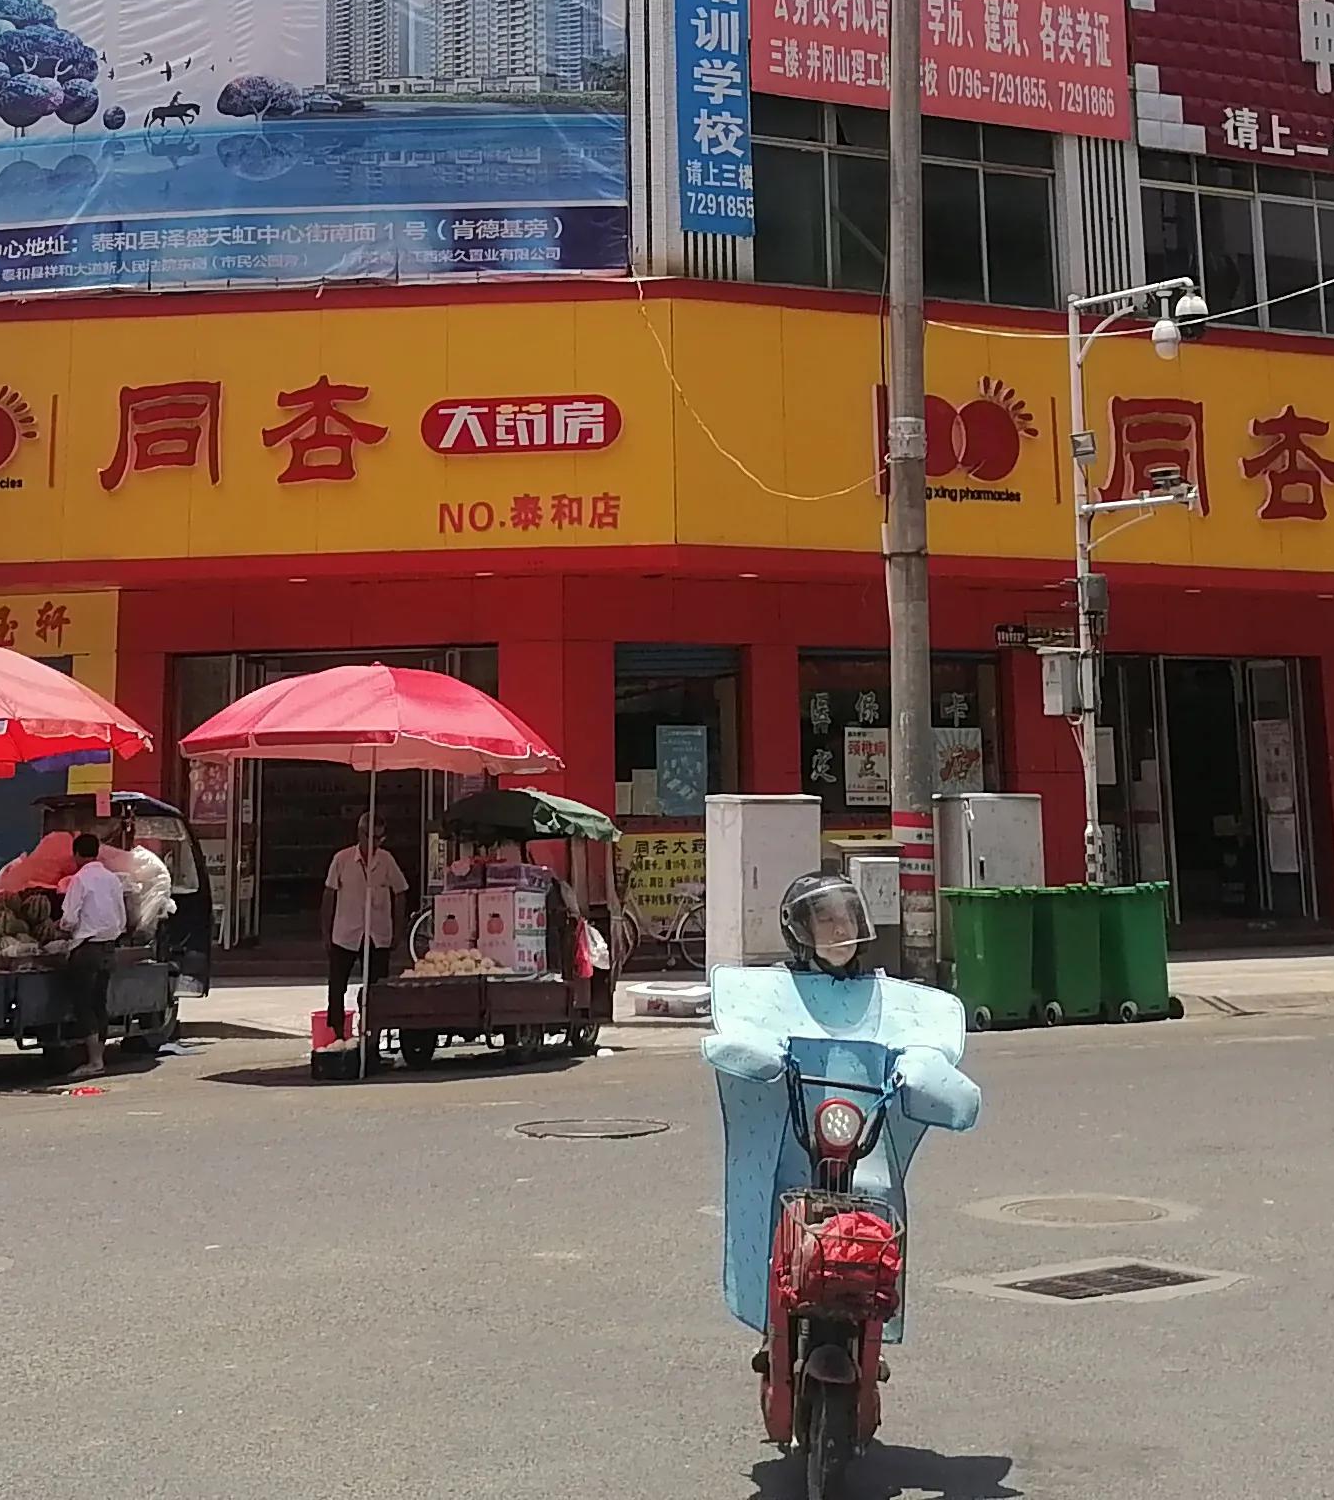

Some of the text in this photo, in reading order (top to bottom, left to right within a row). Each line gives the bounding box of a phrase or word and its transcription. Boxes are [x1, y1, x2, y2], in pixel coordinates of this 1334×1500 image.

[685, 158, 754, 191] 请上三楼
[686, 191, 755, 219] 7291855
[99, 373, 605, 493] 同杏 大药房
[933, 487, 958, 501] xing
[959, 487, 1021, 502] pharmacies
